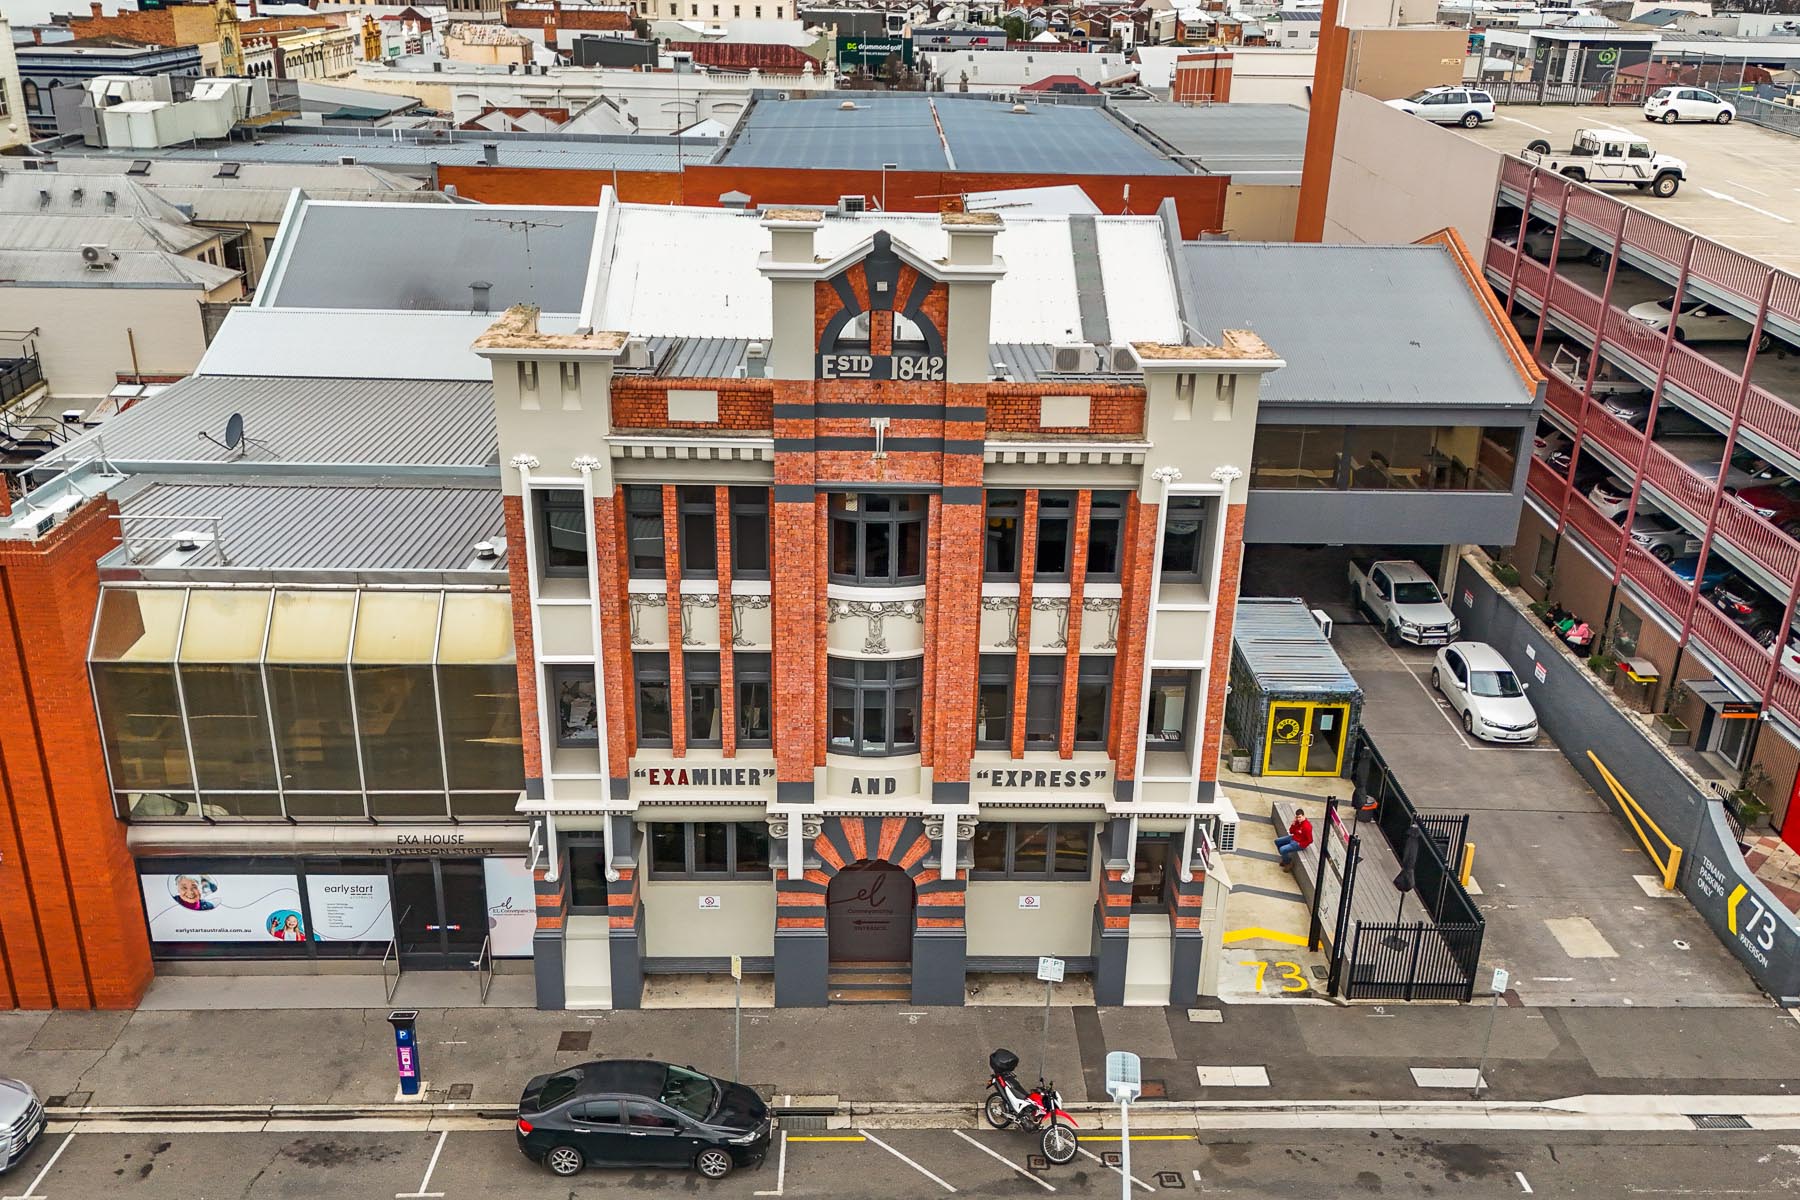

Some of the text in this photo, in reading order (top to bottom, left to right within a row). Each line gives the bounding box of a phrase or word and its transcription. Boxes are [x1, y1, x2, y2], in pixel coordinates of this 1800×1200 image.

[822, 355, 944, 380] ESTD 1842
[634, 768, 775, 786] “EXAMINER”
[850, 777, 897, 795] AND
[976, 770, 1107, 787] “EXPRESS”
[397, 834, 464, 844] EXA HOUSE
[1702, 856, 1726, 883] TENANT
[324, 884, 350, 894] early
[1698, 878, 1714, 897] ONLY
[1700, 866, 1724, 896] PARKING
[1745, 896, 1776, 950] 73
[1740, 934, 1768, 968] PATERSON
[1238, 961, 1308, 992] 73
